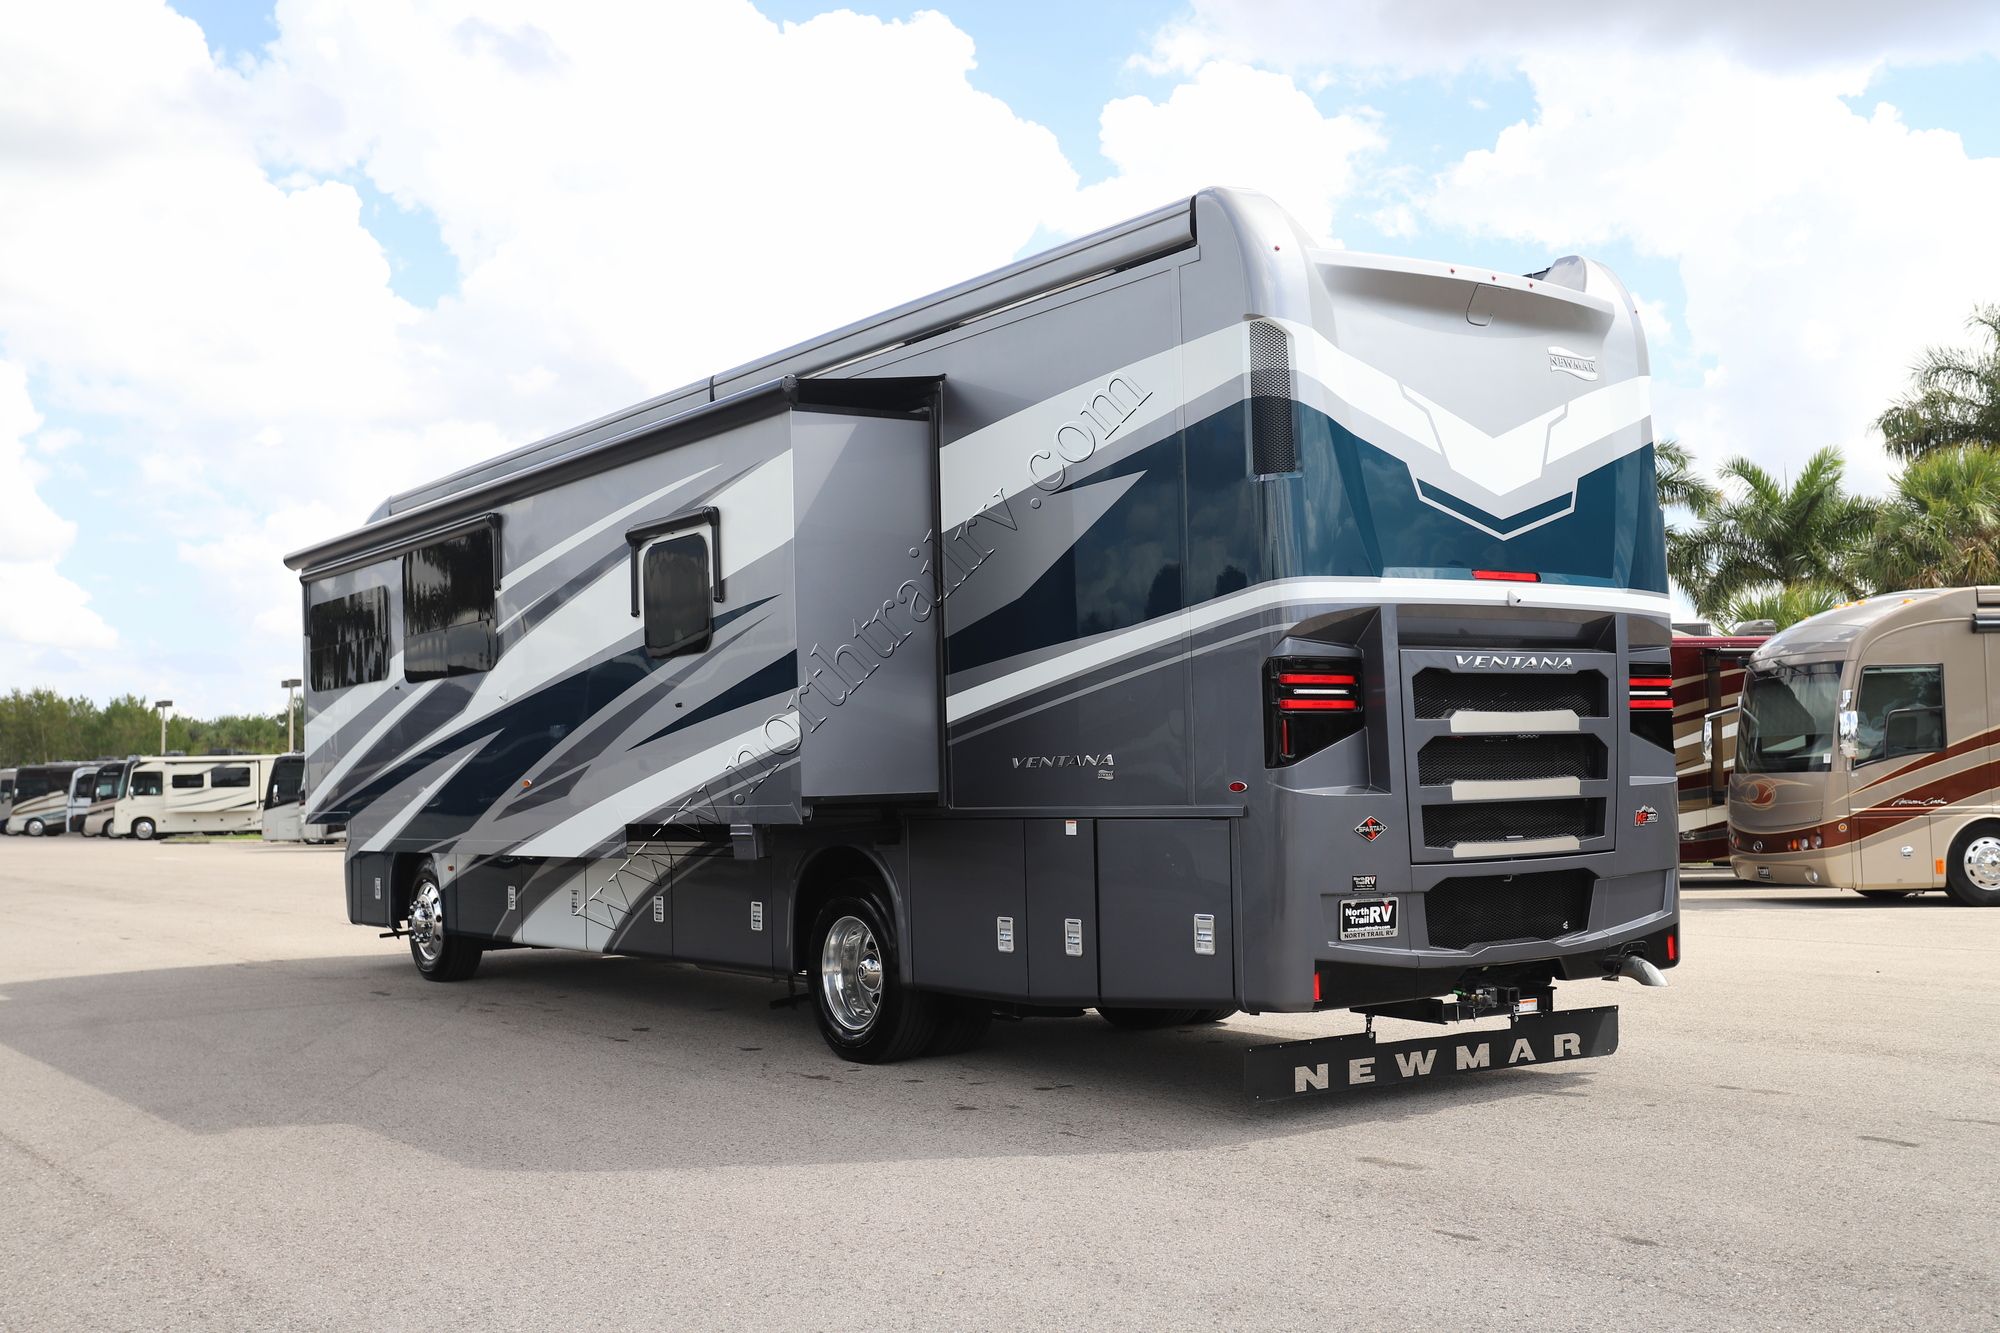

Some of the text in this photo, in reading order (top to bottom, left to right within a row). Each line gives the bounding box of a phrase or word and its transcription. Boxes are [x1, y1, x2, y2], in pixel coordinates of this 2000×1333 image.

[1550, 356, 1596, 373] NEWMAR
[1455, 654, 1574, 670] VENTANA
[1012, 754, 1114, 769] VENTANA
[1364, 876, 1376, 885] RV
[1345, 907, 1370, 917] North
[1369, 905, 1393, 923] RV
[1350, 915, 1370, 925] Trail
[1344, 931, 1366, 939] NORTH
[1294, 1032, 1582, 1093] NEWMAR
